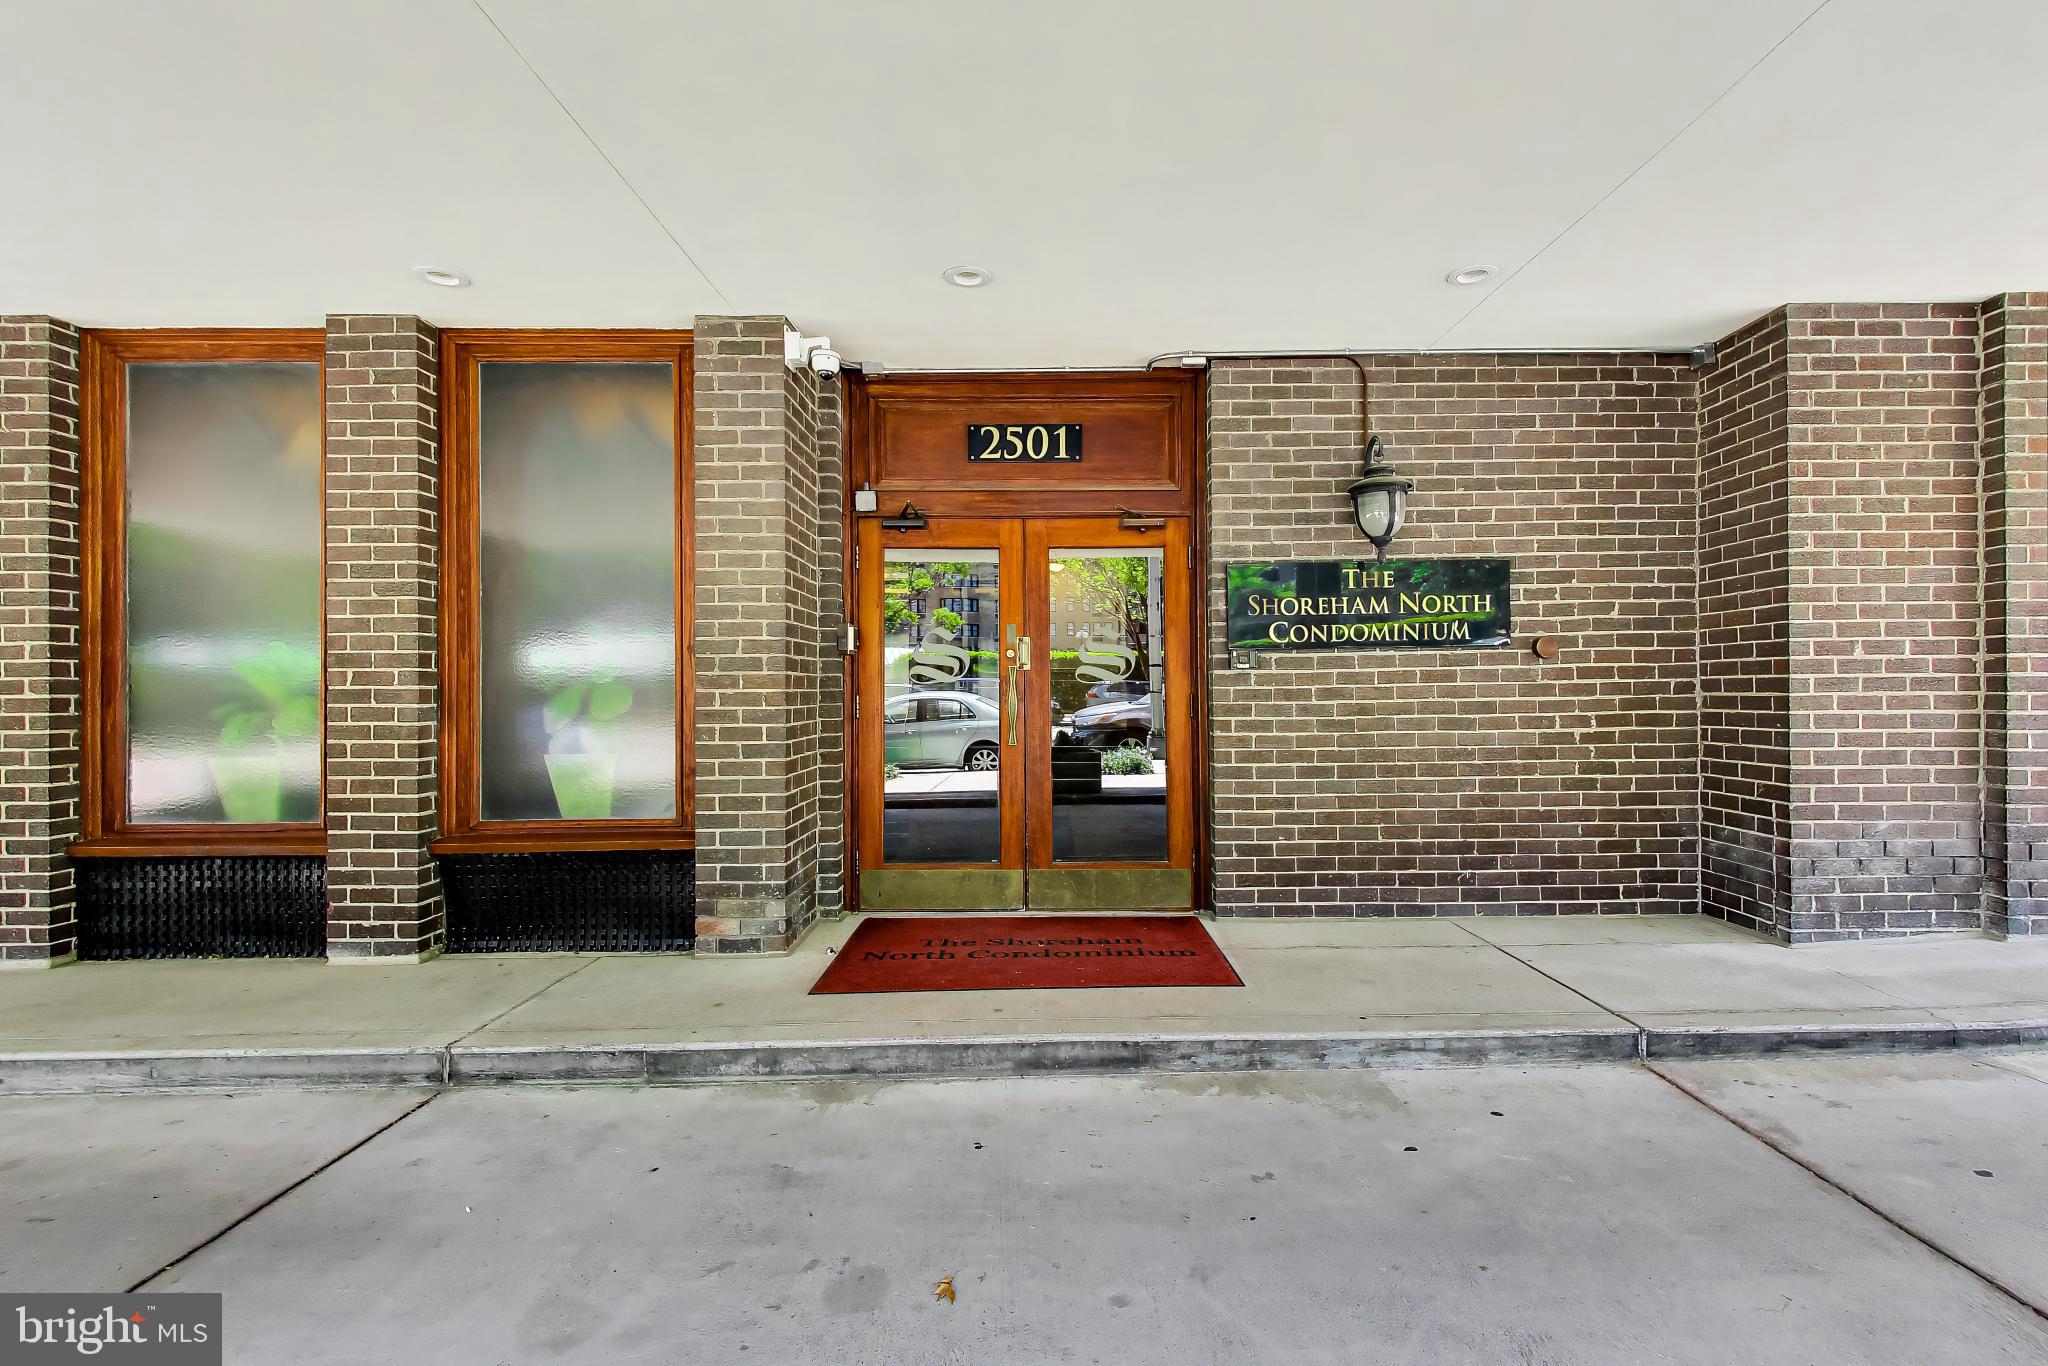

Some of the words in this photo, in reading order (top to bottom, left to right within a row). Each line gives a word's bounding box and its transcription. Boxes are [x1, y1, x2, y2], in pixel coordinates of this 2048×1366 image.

[979, 425, 1071, 460] 2501
[1342, 568, 1395, 589] THE
[1247, 594, 1391, 616] SHOREHAM
[1399, 592, 1492, 614] NORTH
[1268, 620, 1471, 643] CONDOMINIUM
[921, 937, 978, 948] The
[985, 936, 1143, 947] Shoreham
[861, 949, 957, 961] North
[966, 947, 1199, 960] Condominium
